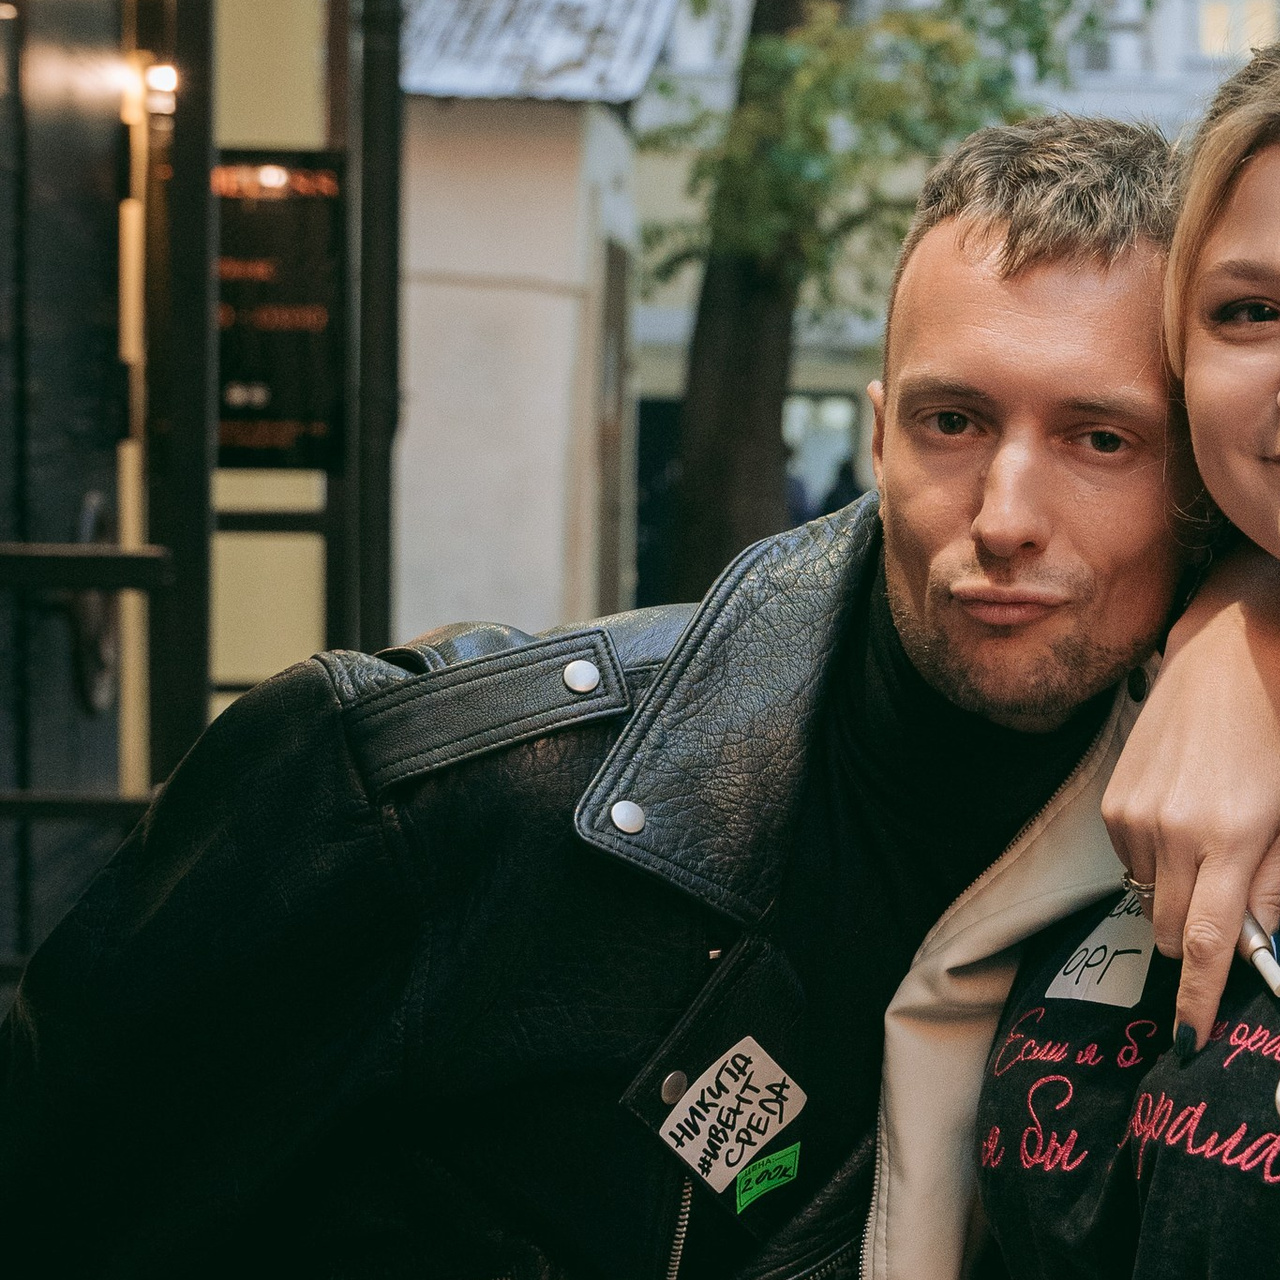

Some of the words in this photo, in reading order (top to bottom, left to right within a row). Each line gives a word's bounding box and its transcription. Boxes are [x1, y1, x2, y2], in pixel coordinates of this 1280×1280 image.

[994, 1007, 1069, 1076] Если
[1075, 1043, 1104, 1065] я
[668, 1053, 753, 1148] НИКИТА
[725, 1076, 790, 1167] СРЕДА
[1020, 1075, 1088, 1171] бы
